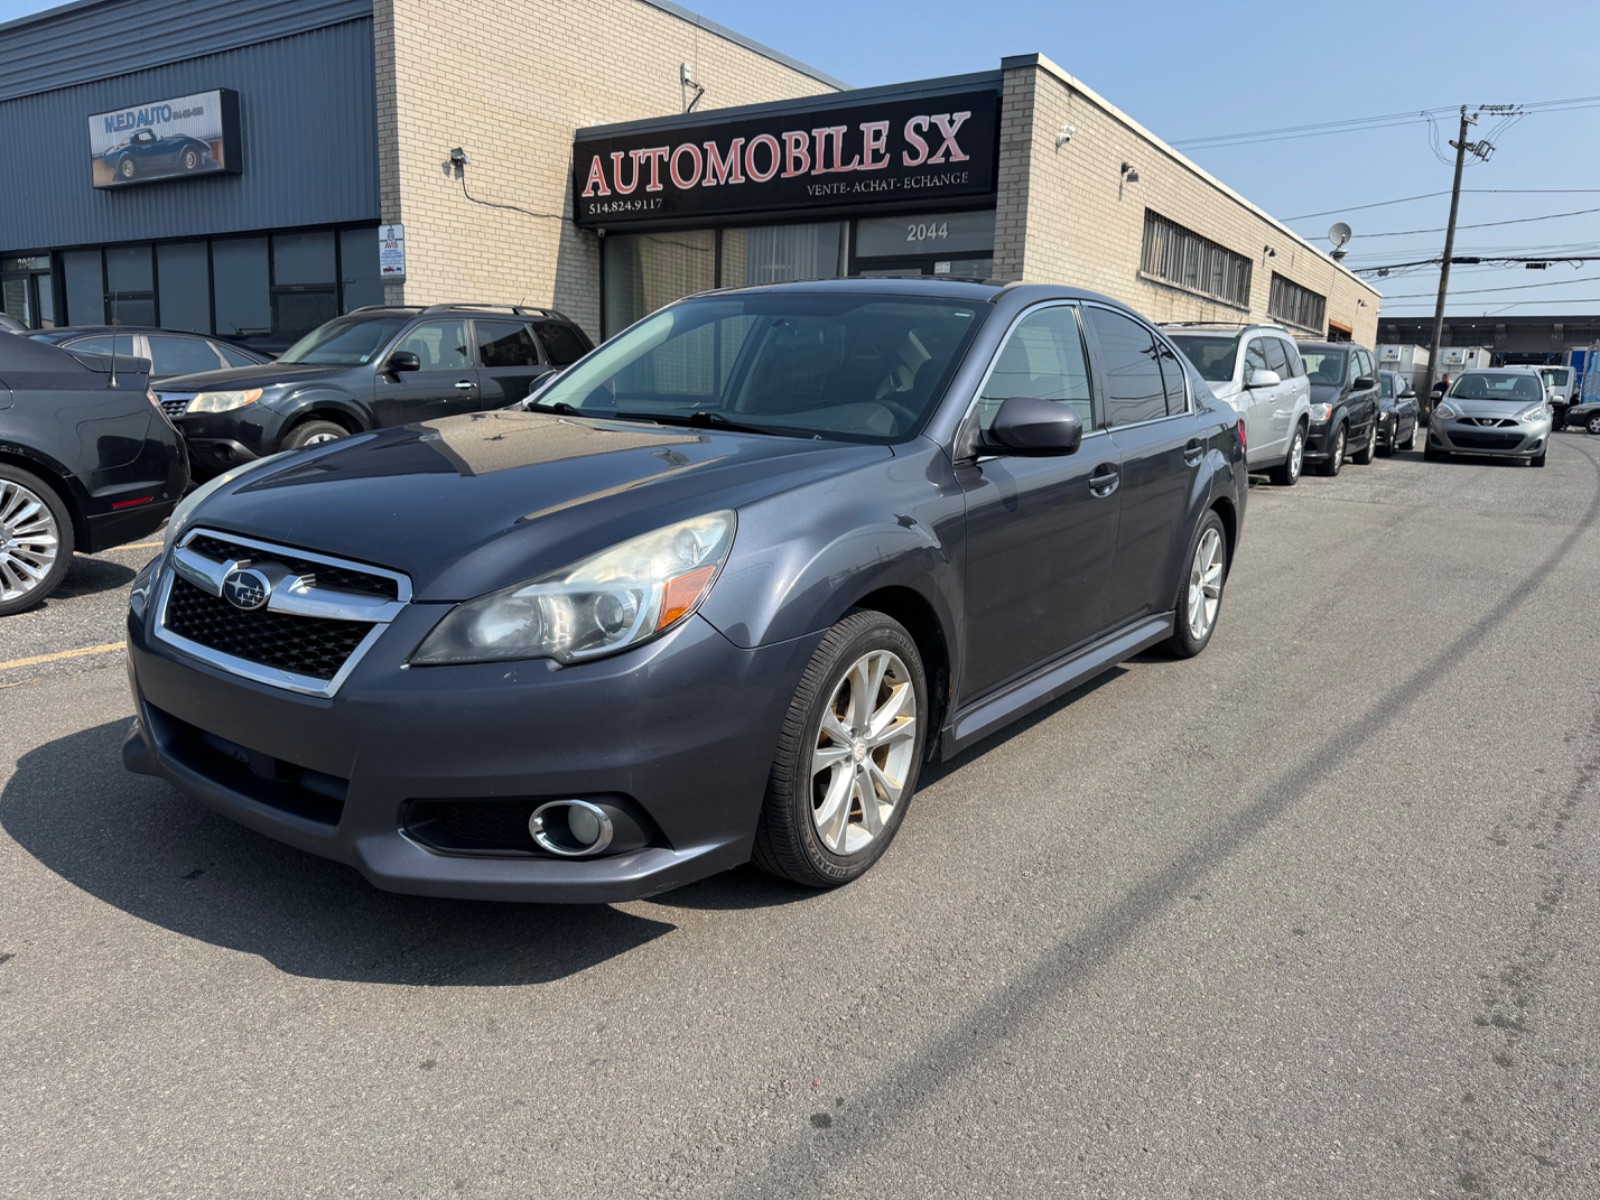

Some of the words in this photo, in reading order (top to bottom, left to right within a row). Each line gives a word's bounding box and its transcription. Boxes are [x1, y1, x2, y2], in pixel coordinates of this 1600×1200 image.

[136, 104, 172, 127] AUTO
[581, 120, 891, 198] AUTOMOBILE
[902, 111, 971, 168] SX
[903, 171, 969, 189] ECHANGE
[588, 197, 663, 215] 514.824.9117
[906, 222, 949, 242] 2044
[807, 839, 849, 877] TURANZA
